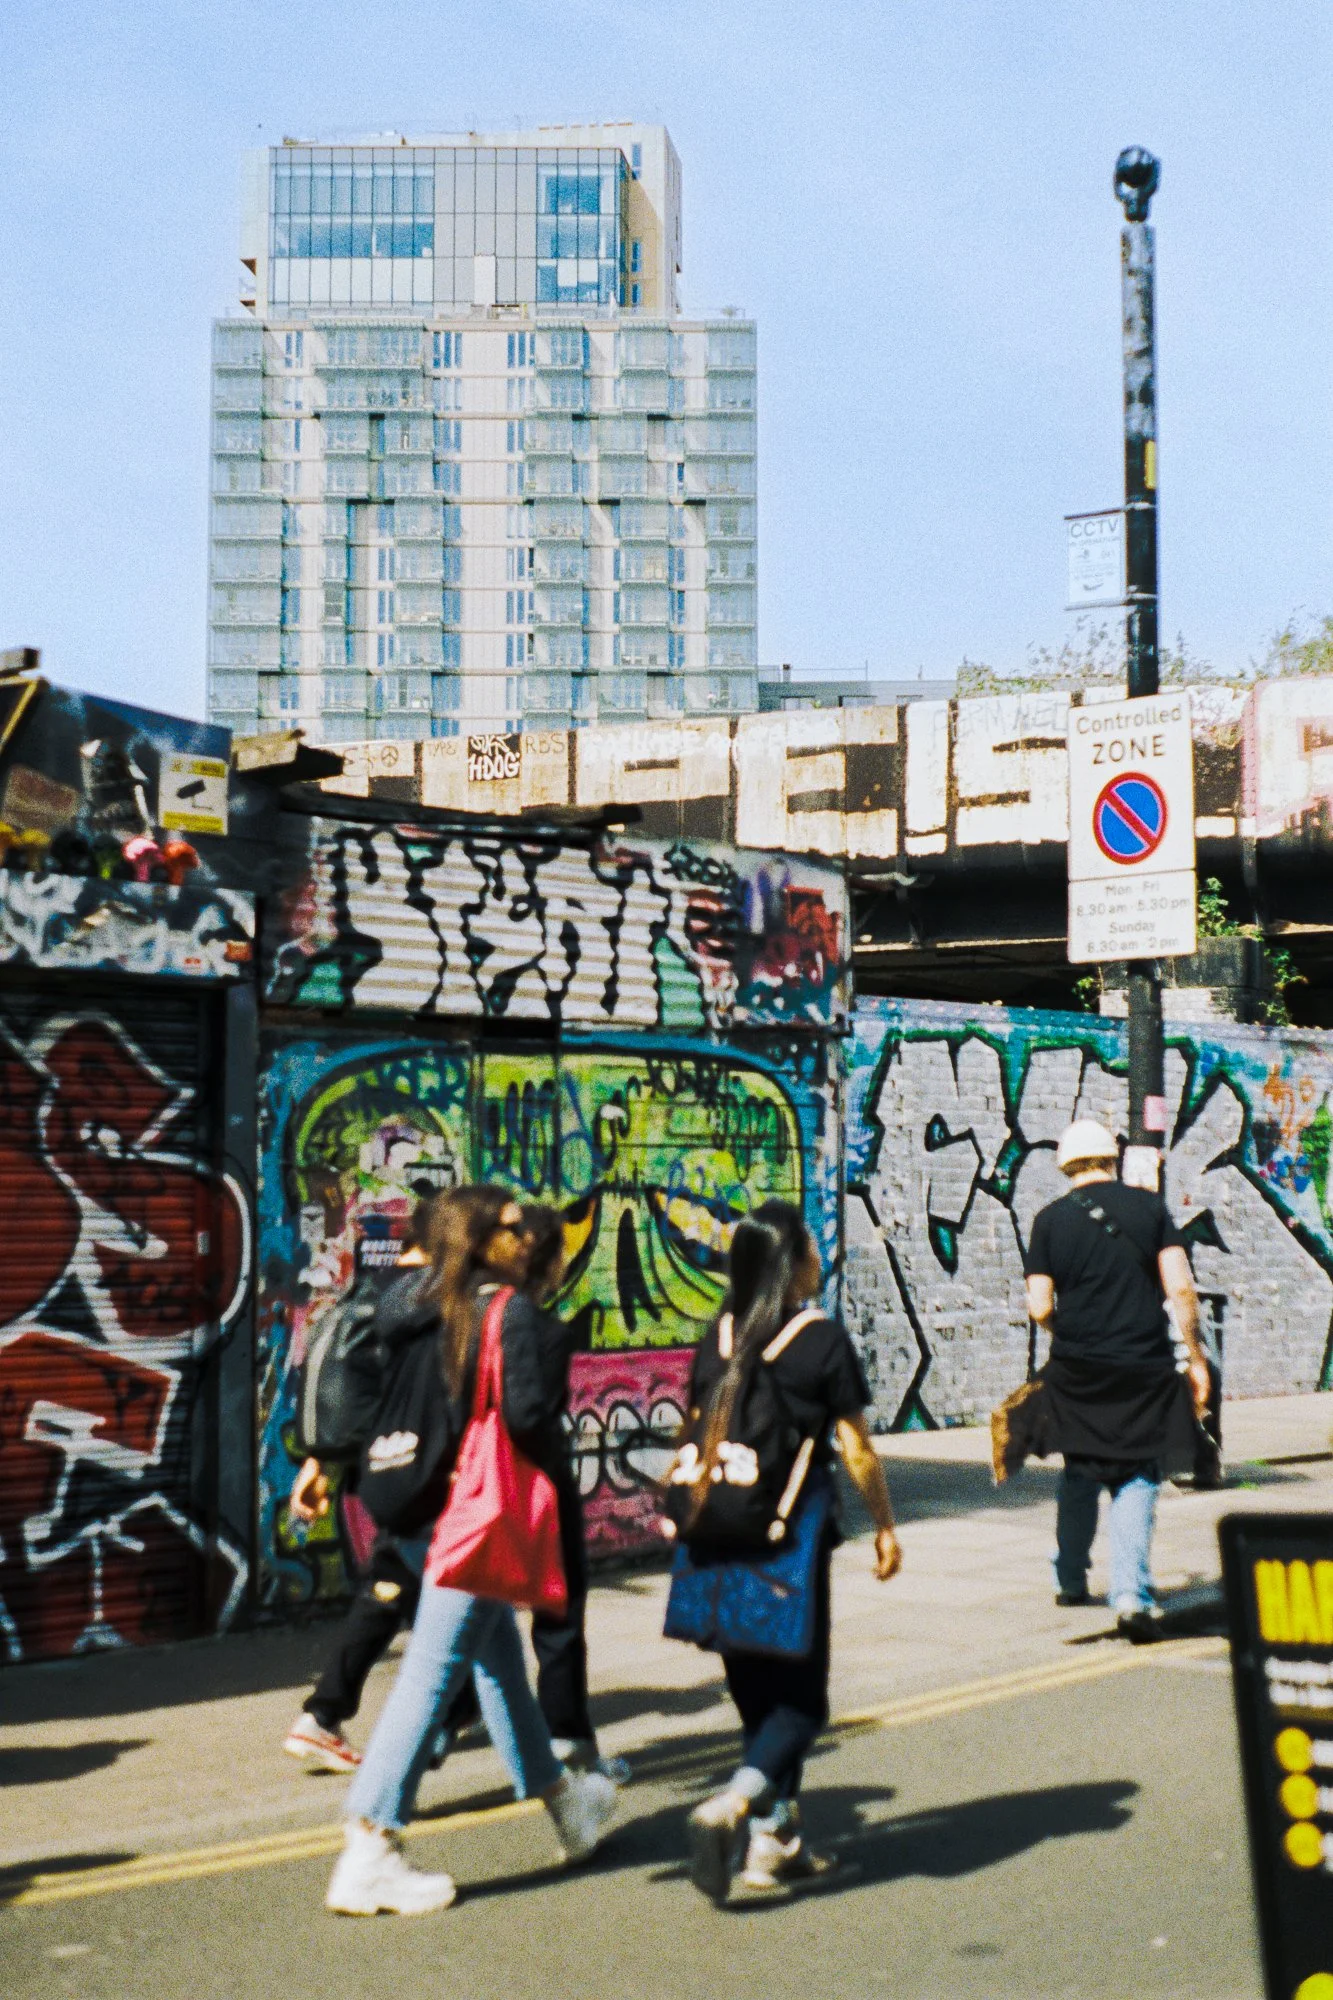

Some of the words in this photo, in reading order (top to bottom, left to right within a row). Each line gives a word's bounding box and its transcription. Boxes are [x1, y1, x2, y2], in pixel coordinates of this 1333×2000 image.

[1070, 518, 1119, 538] CCTV
[1076, 703, 1182, 734] Controlled
[524, 732, 567, 754] RBS
[1092, 734, 1165, 765] ZONE
[1105, 884, 1133, 896] Mon
[1142, 880, 1160, 892] Fri
[1108, 919, 1156, 934] Sunday
